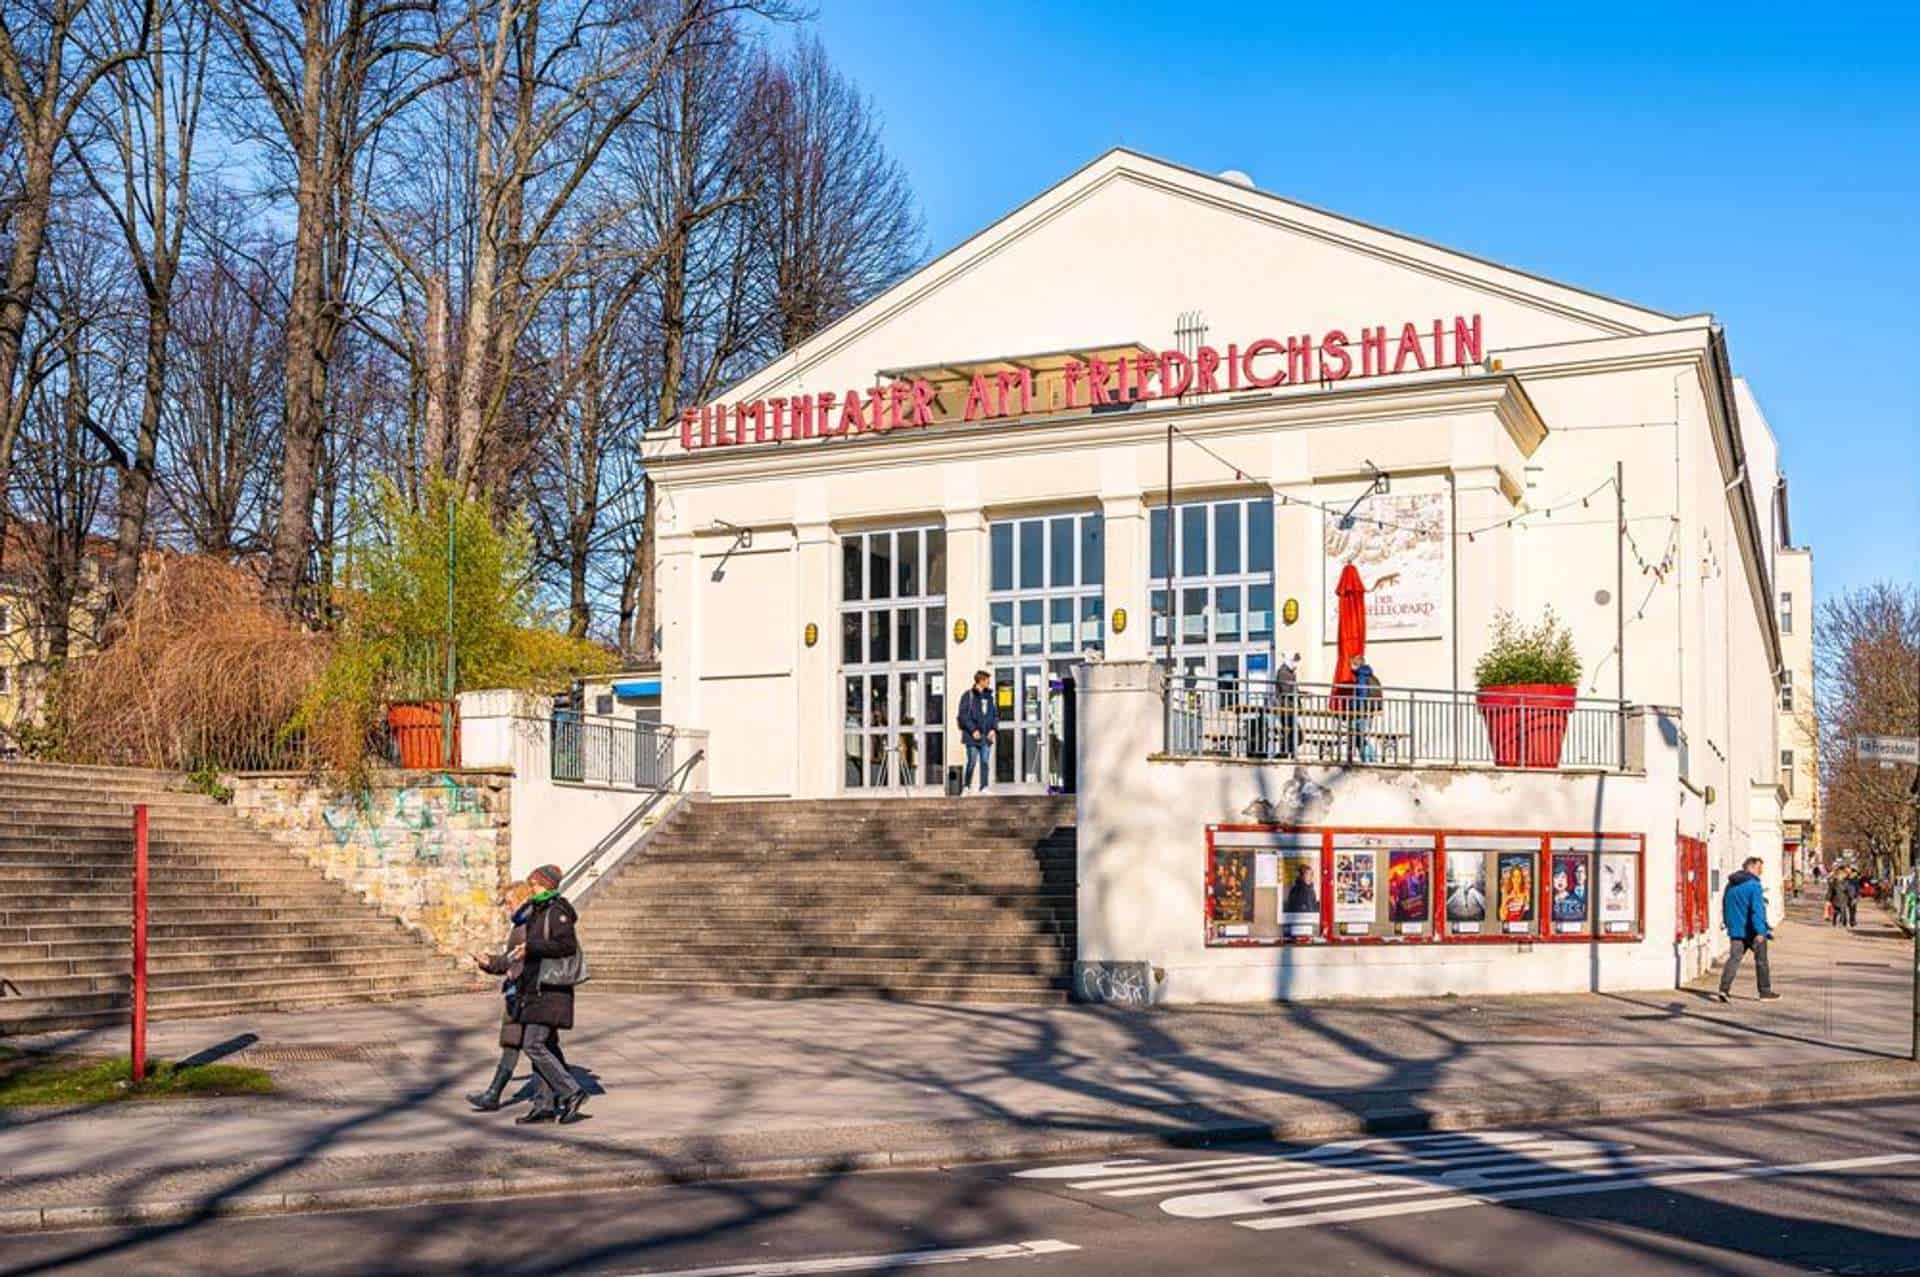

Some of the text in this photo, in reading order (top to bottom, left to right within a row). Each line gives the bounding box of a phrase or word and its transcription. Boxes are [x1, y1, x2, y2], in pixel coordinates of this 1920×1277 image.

[681, 314, 1482, 448] FILMTHEATER AM FRIEDRICHSHAIN
